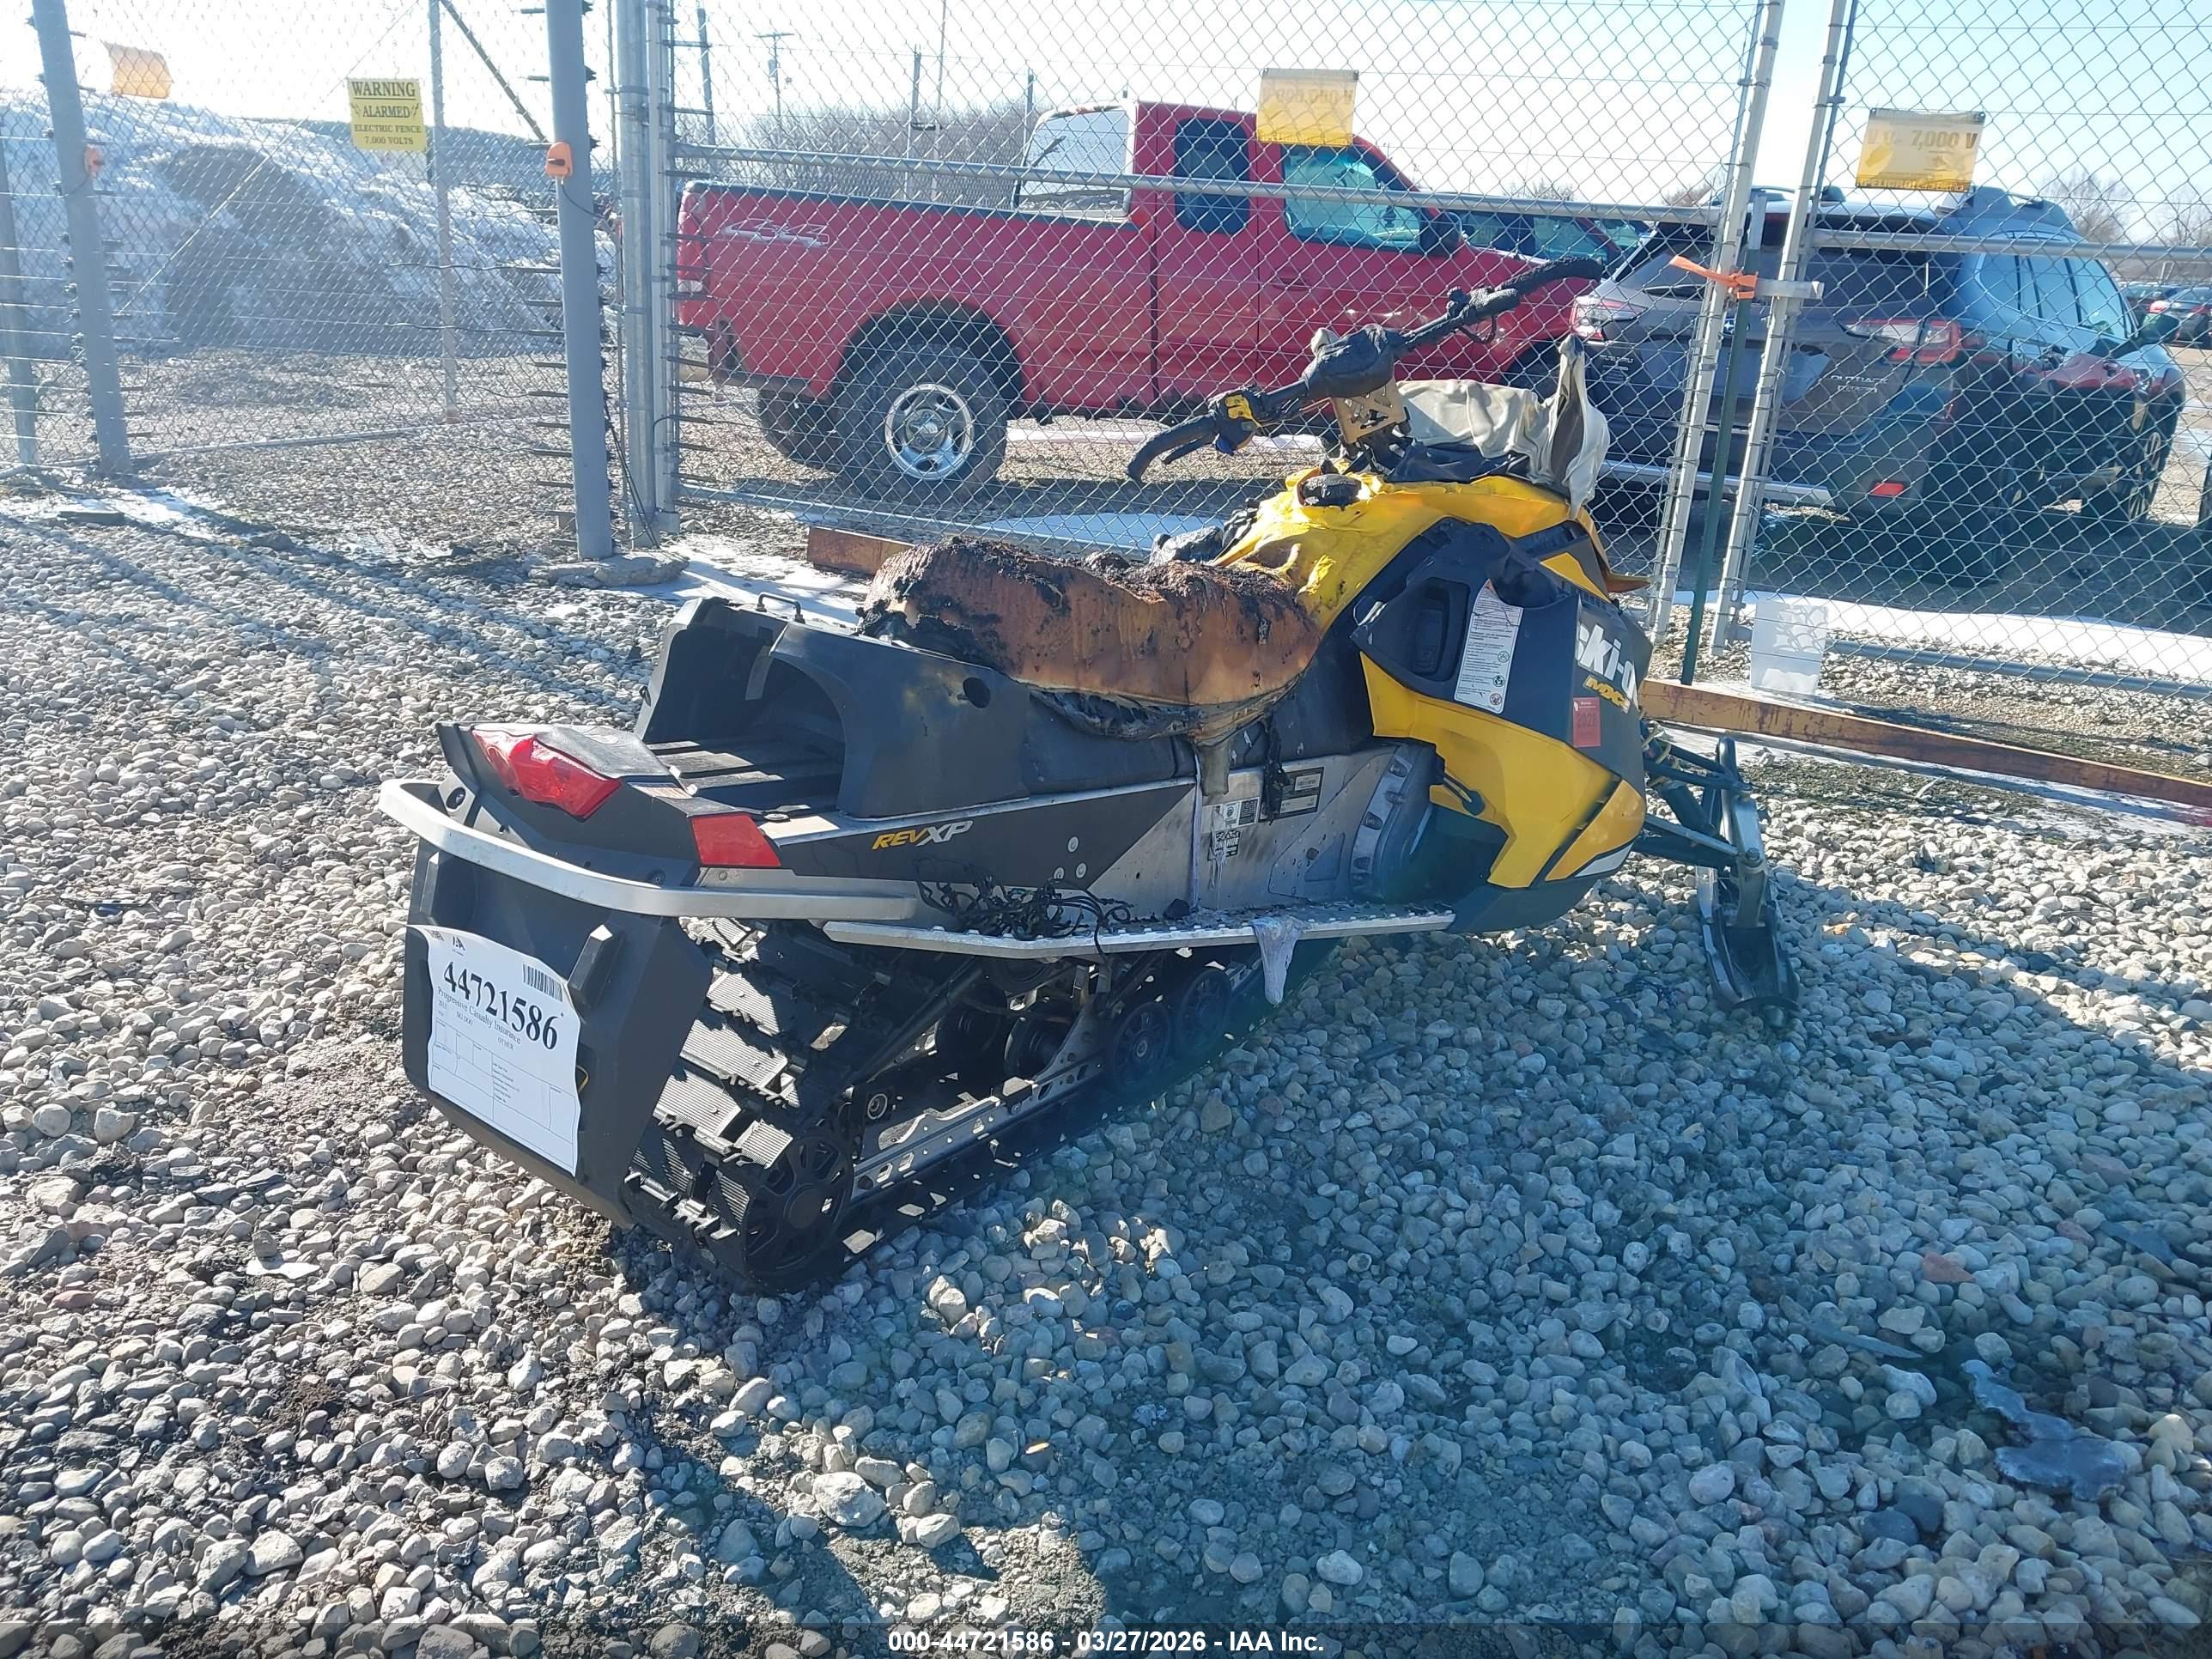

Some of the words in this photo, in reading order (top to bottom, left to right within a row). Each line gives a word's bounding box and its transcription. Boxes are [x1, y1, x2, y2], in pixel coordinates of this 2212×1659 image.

[351, 82, 416, 97] WARNING
[362, 106, 410, 118] ALARMED
[354, 124, 394, 133] ELECTRIC
[395, 125, 422, 134] FENCE
[387, 137, 414, 145] VOLTS
[1911, 130, 1960, 151] 7,000
[1965, 131, 1979, 149] V
[442, 960, 559, 1050] 44721586
[437, 986, 468, 1011] Progressive
[469, 1005, 493, 1028] Casualty
[494, 1019, 522, 1044] Insurance
